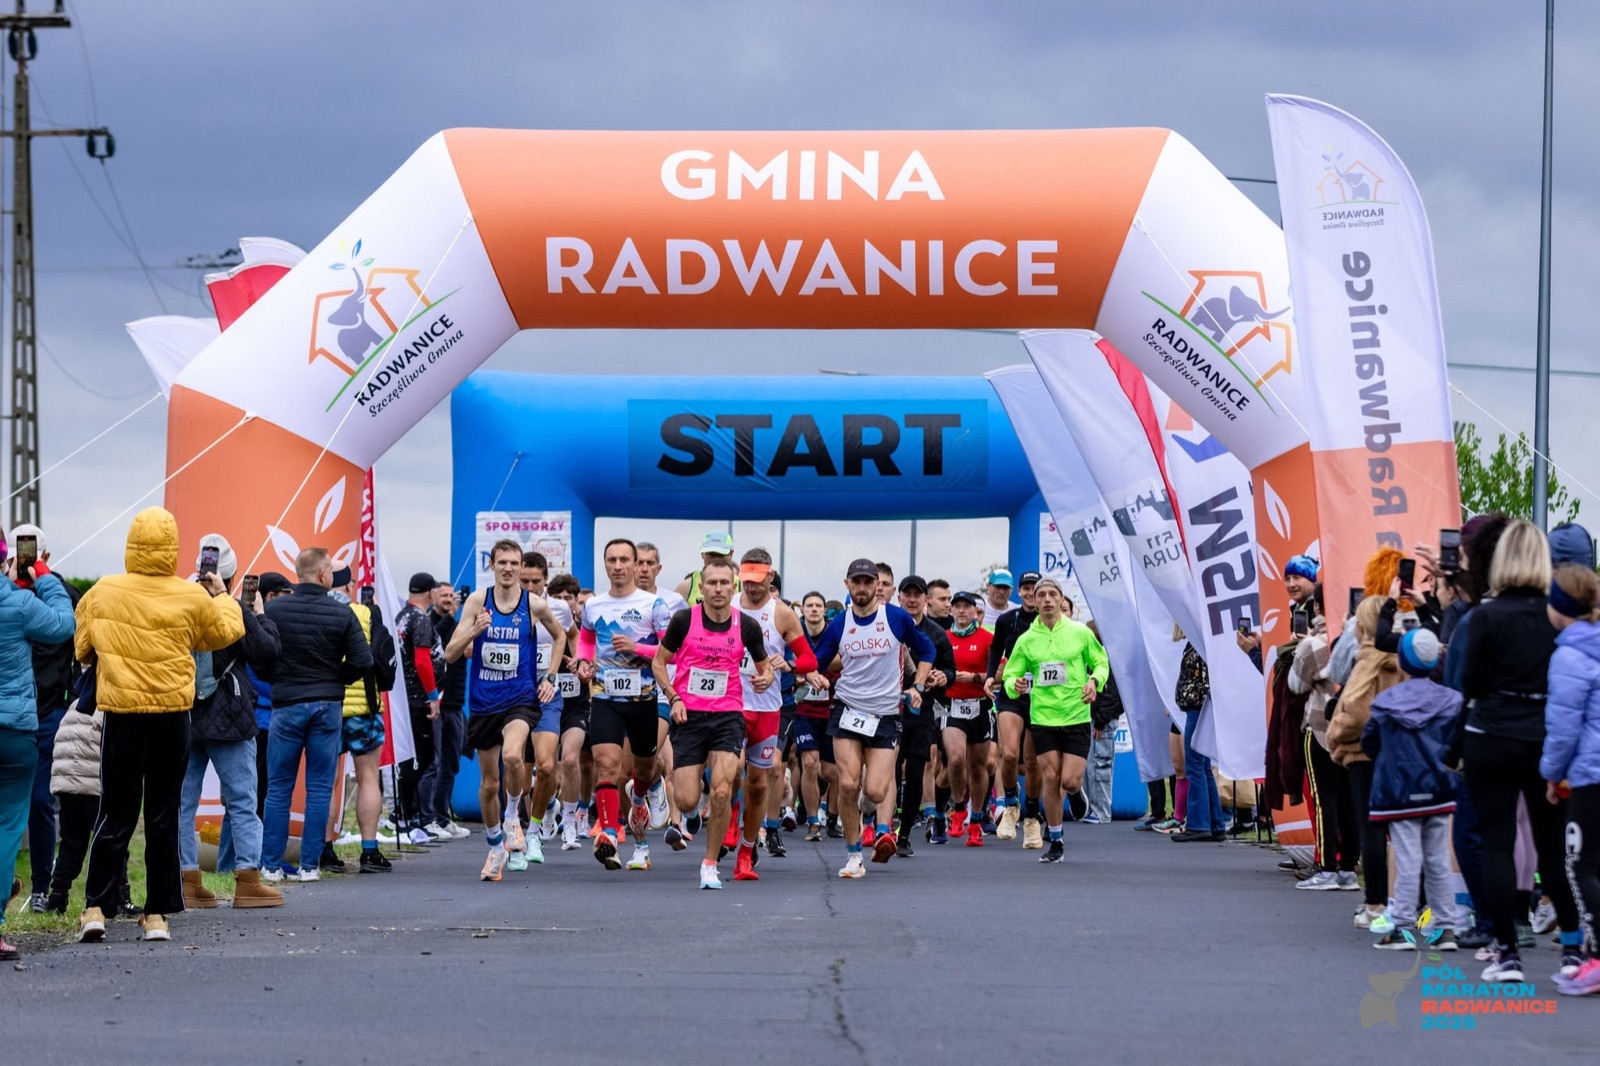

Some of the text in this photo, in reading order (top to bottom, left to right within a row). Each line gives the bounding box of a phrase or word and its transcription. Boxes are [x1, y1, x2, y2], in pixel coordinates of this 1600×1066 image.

[660, 149, 945, 200] GMINA
[545, 237, 1058, 297] RADWANICE
[354, 313, 454, 406] RADWANICE
[1152, 318, 1250, 411] RADWANICE
[368, 329, 464, 417] Szczęśliwa Gmina
[1143, 333, 1237, 421] Szczęśliwa Gmina
[657, 412, 962, 478] START
[485, 521, 564, 531] SPONSORZY
[487, 627, 520, 640] ASTRA
[844, 638, 892, 654] POLSKA
[489, 652, 511, 664] 299
[1043, 670, 1058, 680] 172
[613, 678, 632, 690] 102
[700, 679, 715, 691] 23
[960, 705, 971, 715] 55
[852, 718, 865, 729] 21
